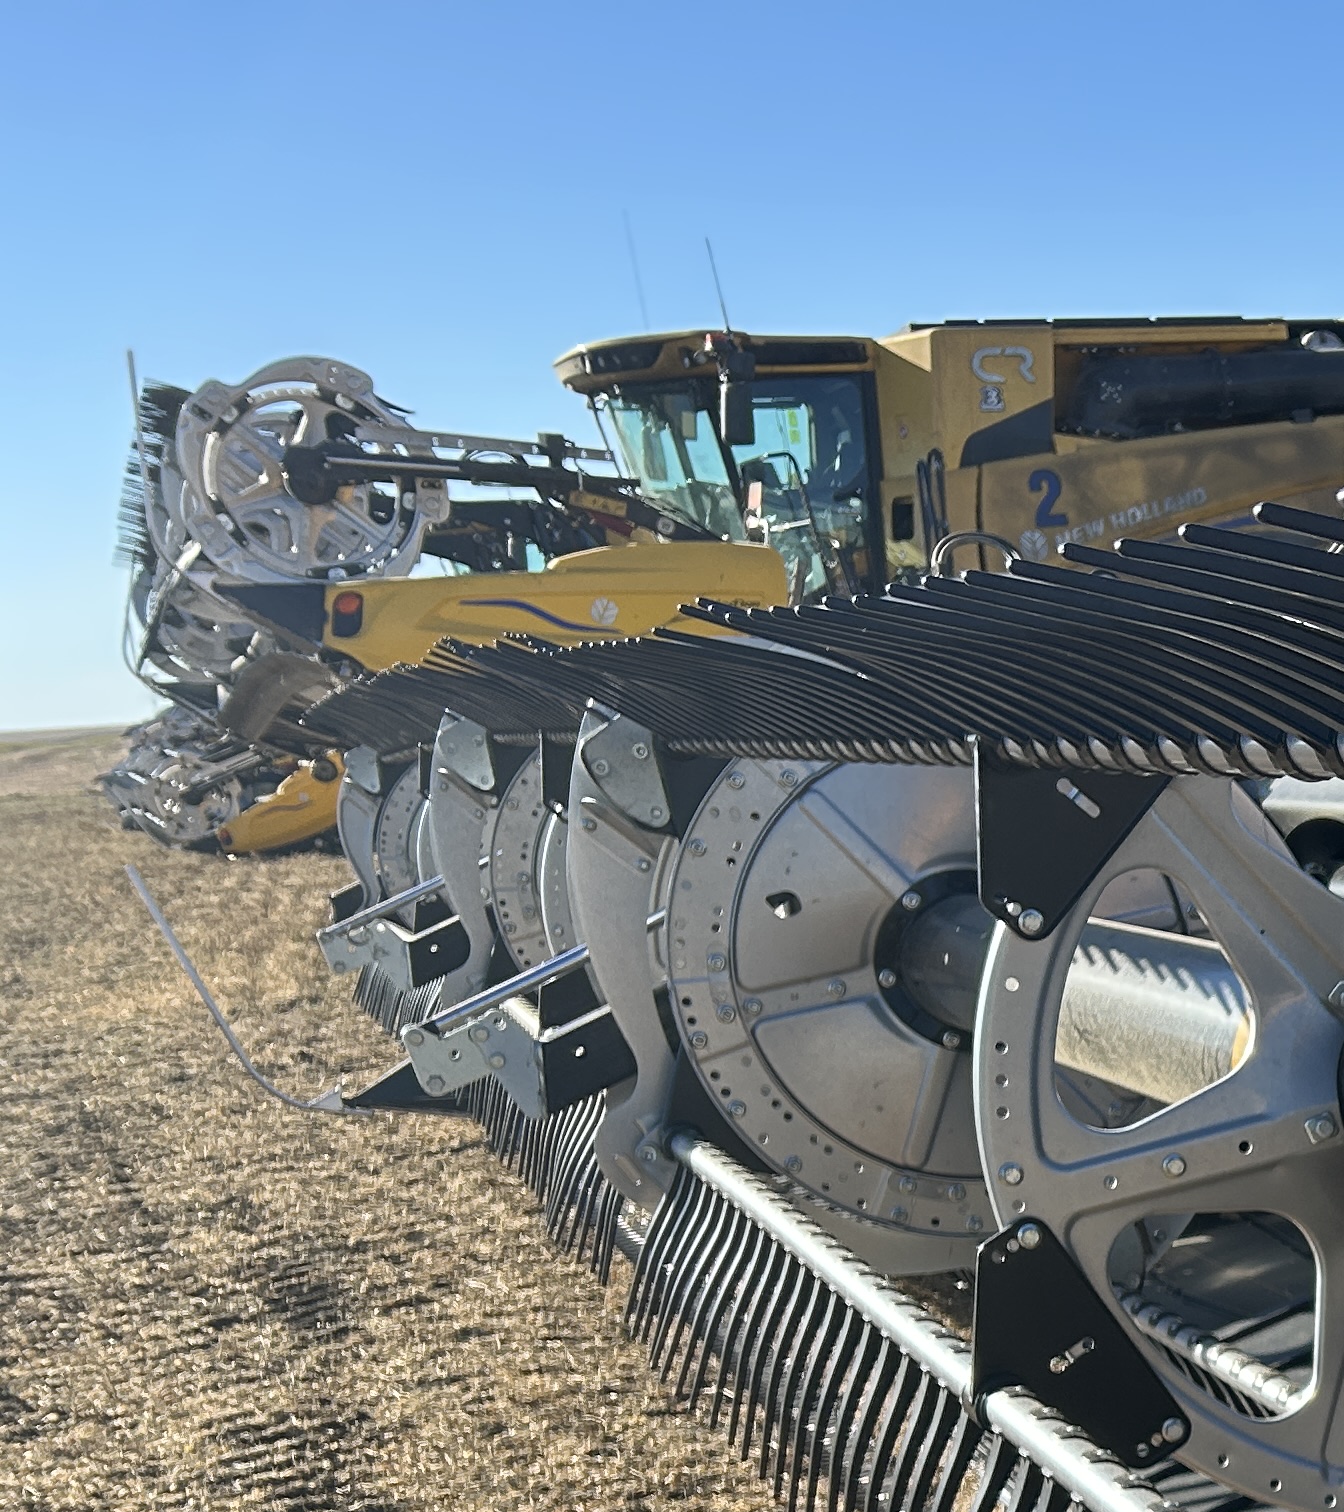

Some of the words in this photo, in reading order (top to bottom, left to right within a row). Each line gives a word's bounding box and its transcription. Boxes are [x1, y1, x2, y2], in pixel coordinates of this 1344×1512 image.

[971, 346, 1036, 384] CR
[1028, 469, 1069, 528] 2
[1109, 486, 1208, 530] HOLLAND
